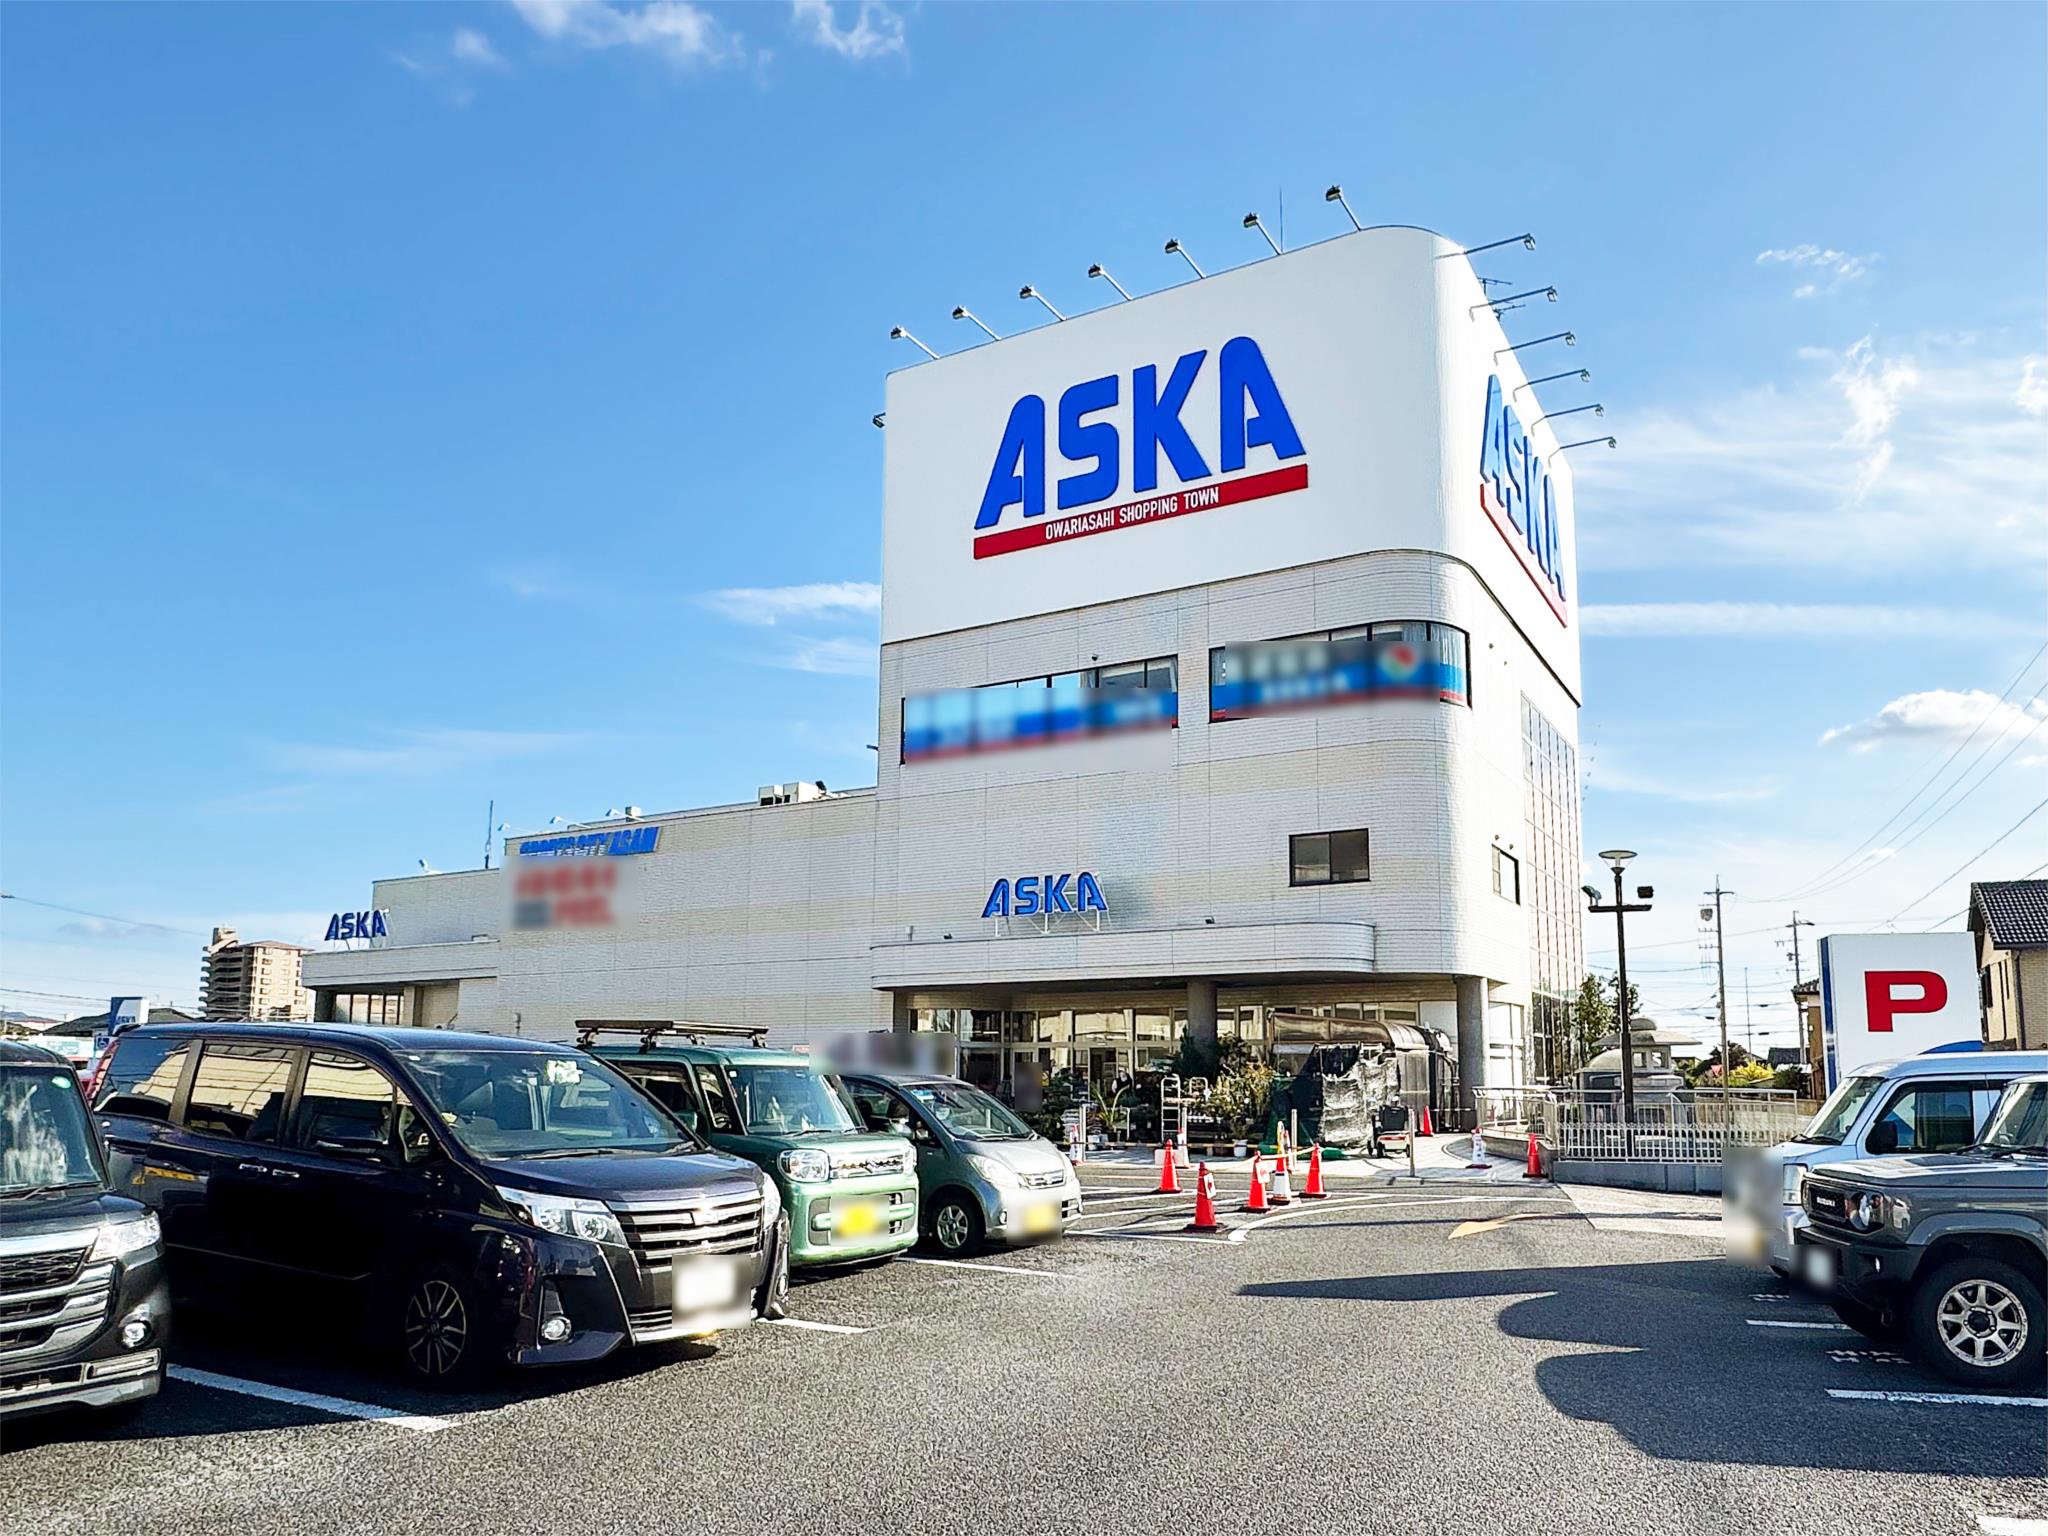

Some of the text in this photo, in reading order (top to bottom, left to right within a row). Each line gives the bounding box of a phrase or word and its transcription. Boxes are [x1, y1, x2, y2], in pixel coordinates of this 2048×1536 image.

[974, 336, 1307, 530] ASKA
[1045, 487, 1219, 540] OWARIASAHI SHOPPING TOWN
[1480, 374, 1566, 602] ASKA
[981, 872, 1108, 918] ASKA
[324, 910, 387, 941] ASKA
[1865, 971, 1948, 1032] P
